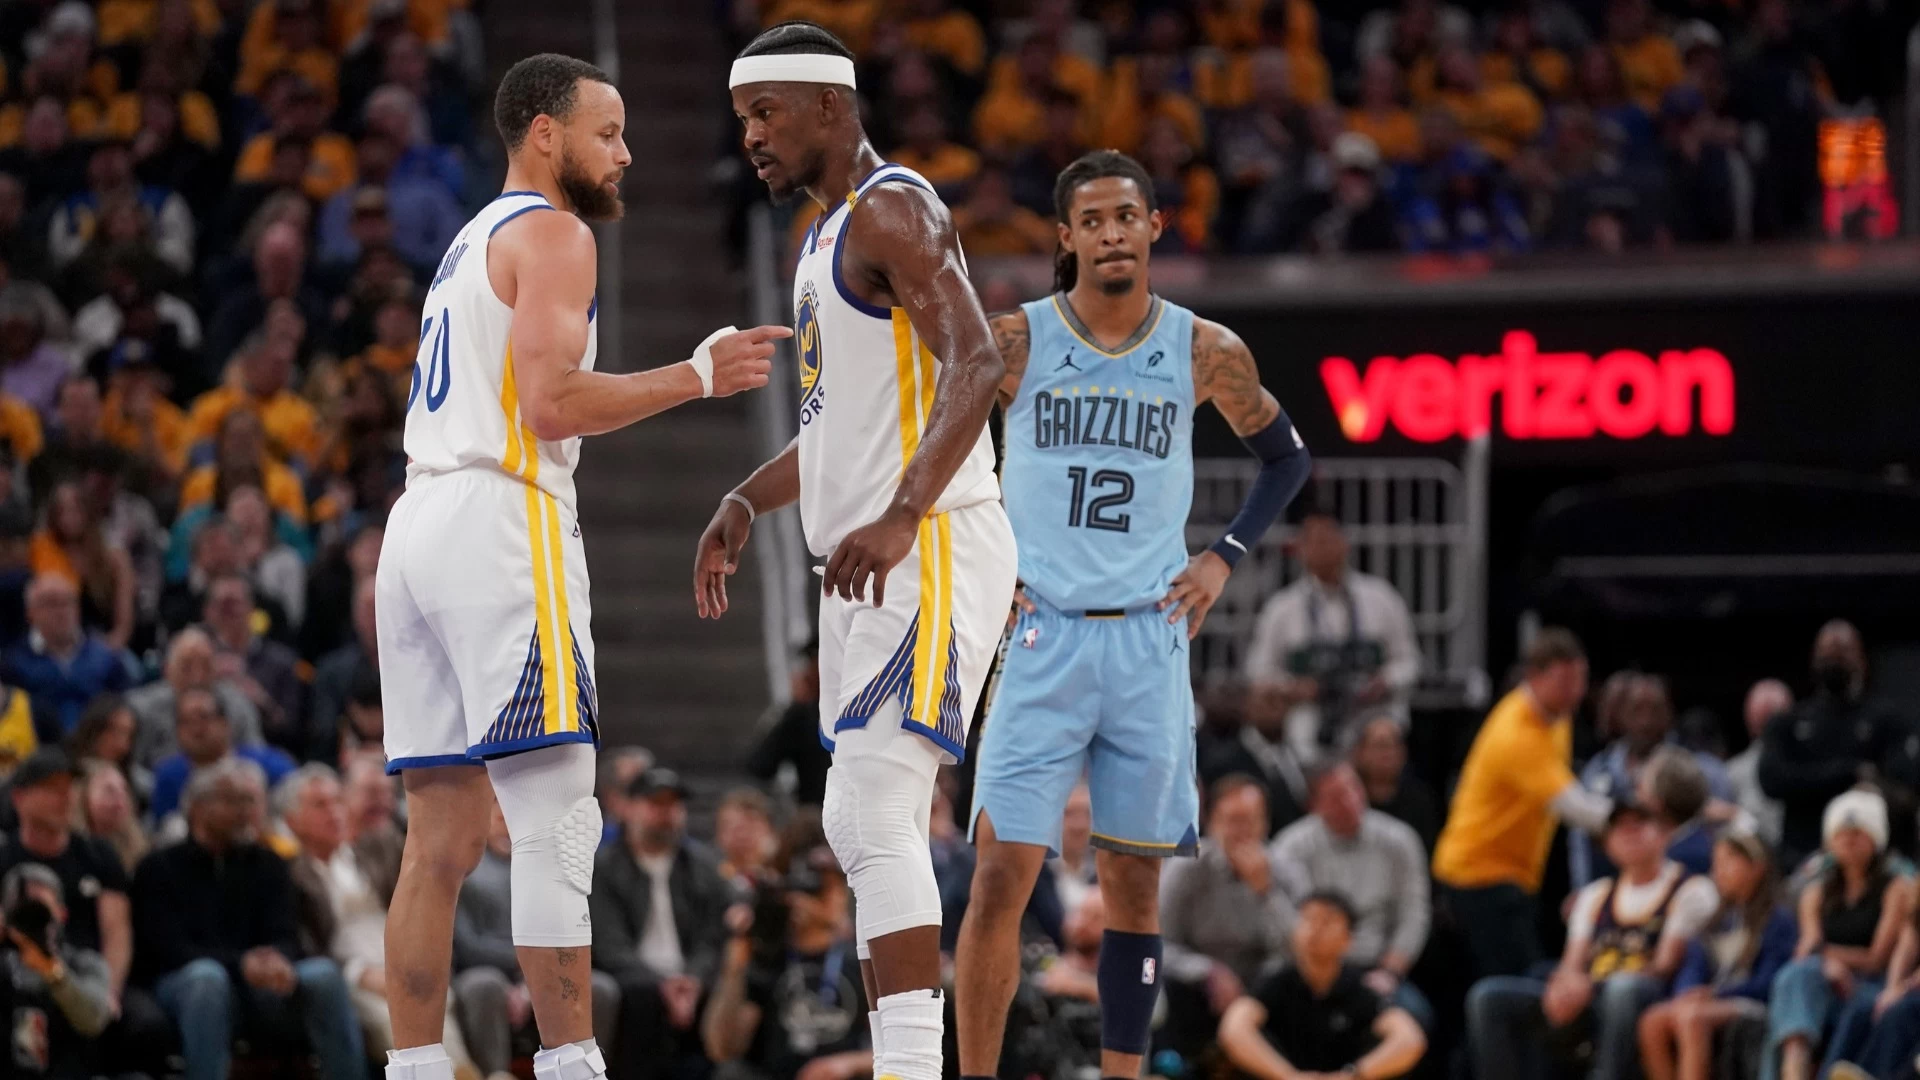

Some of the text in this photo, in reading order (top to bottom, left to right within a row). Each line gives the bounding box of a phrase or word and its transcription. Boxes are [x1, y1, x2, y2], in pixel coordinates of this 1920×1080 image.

[1320, 330, 1735, 443] verizon
[1035, 388, 1178, 460] GRIZZLIES
[1067, 466, 1135, 533] 12
